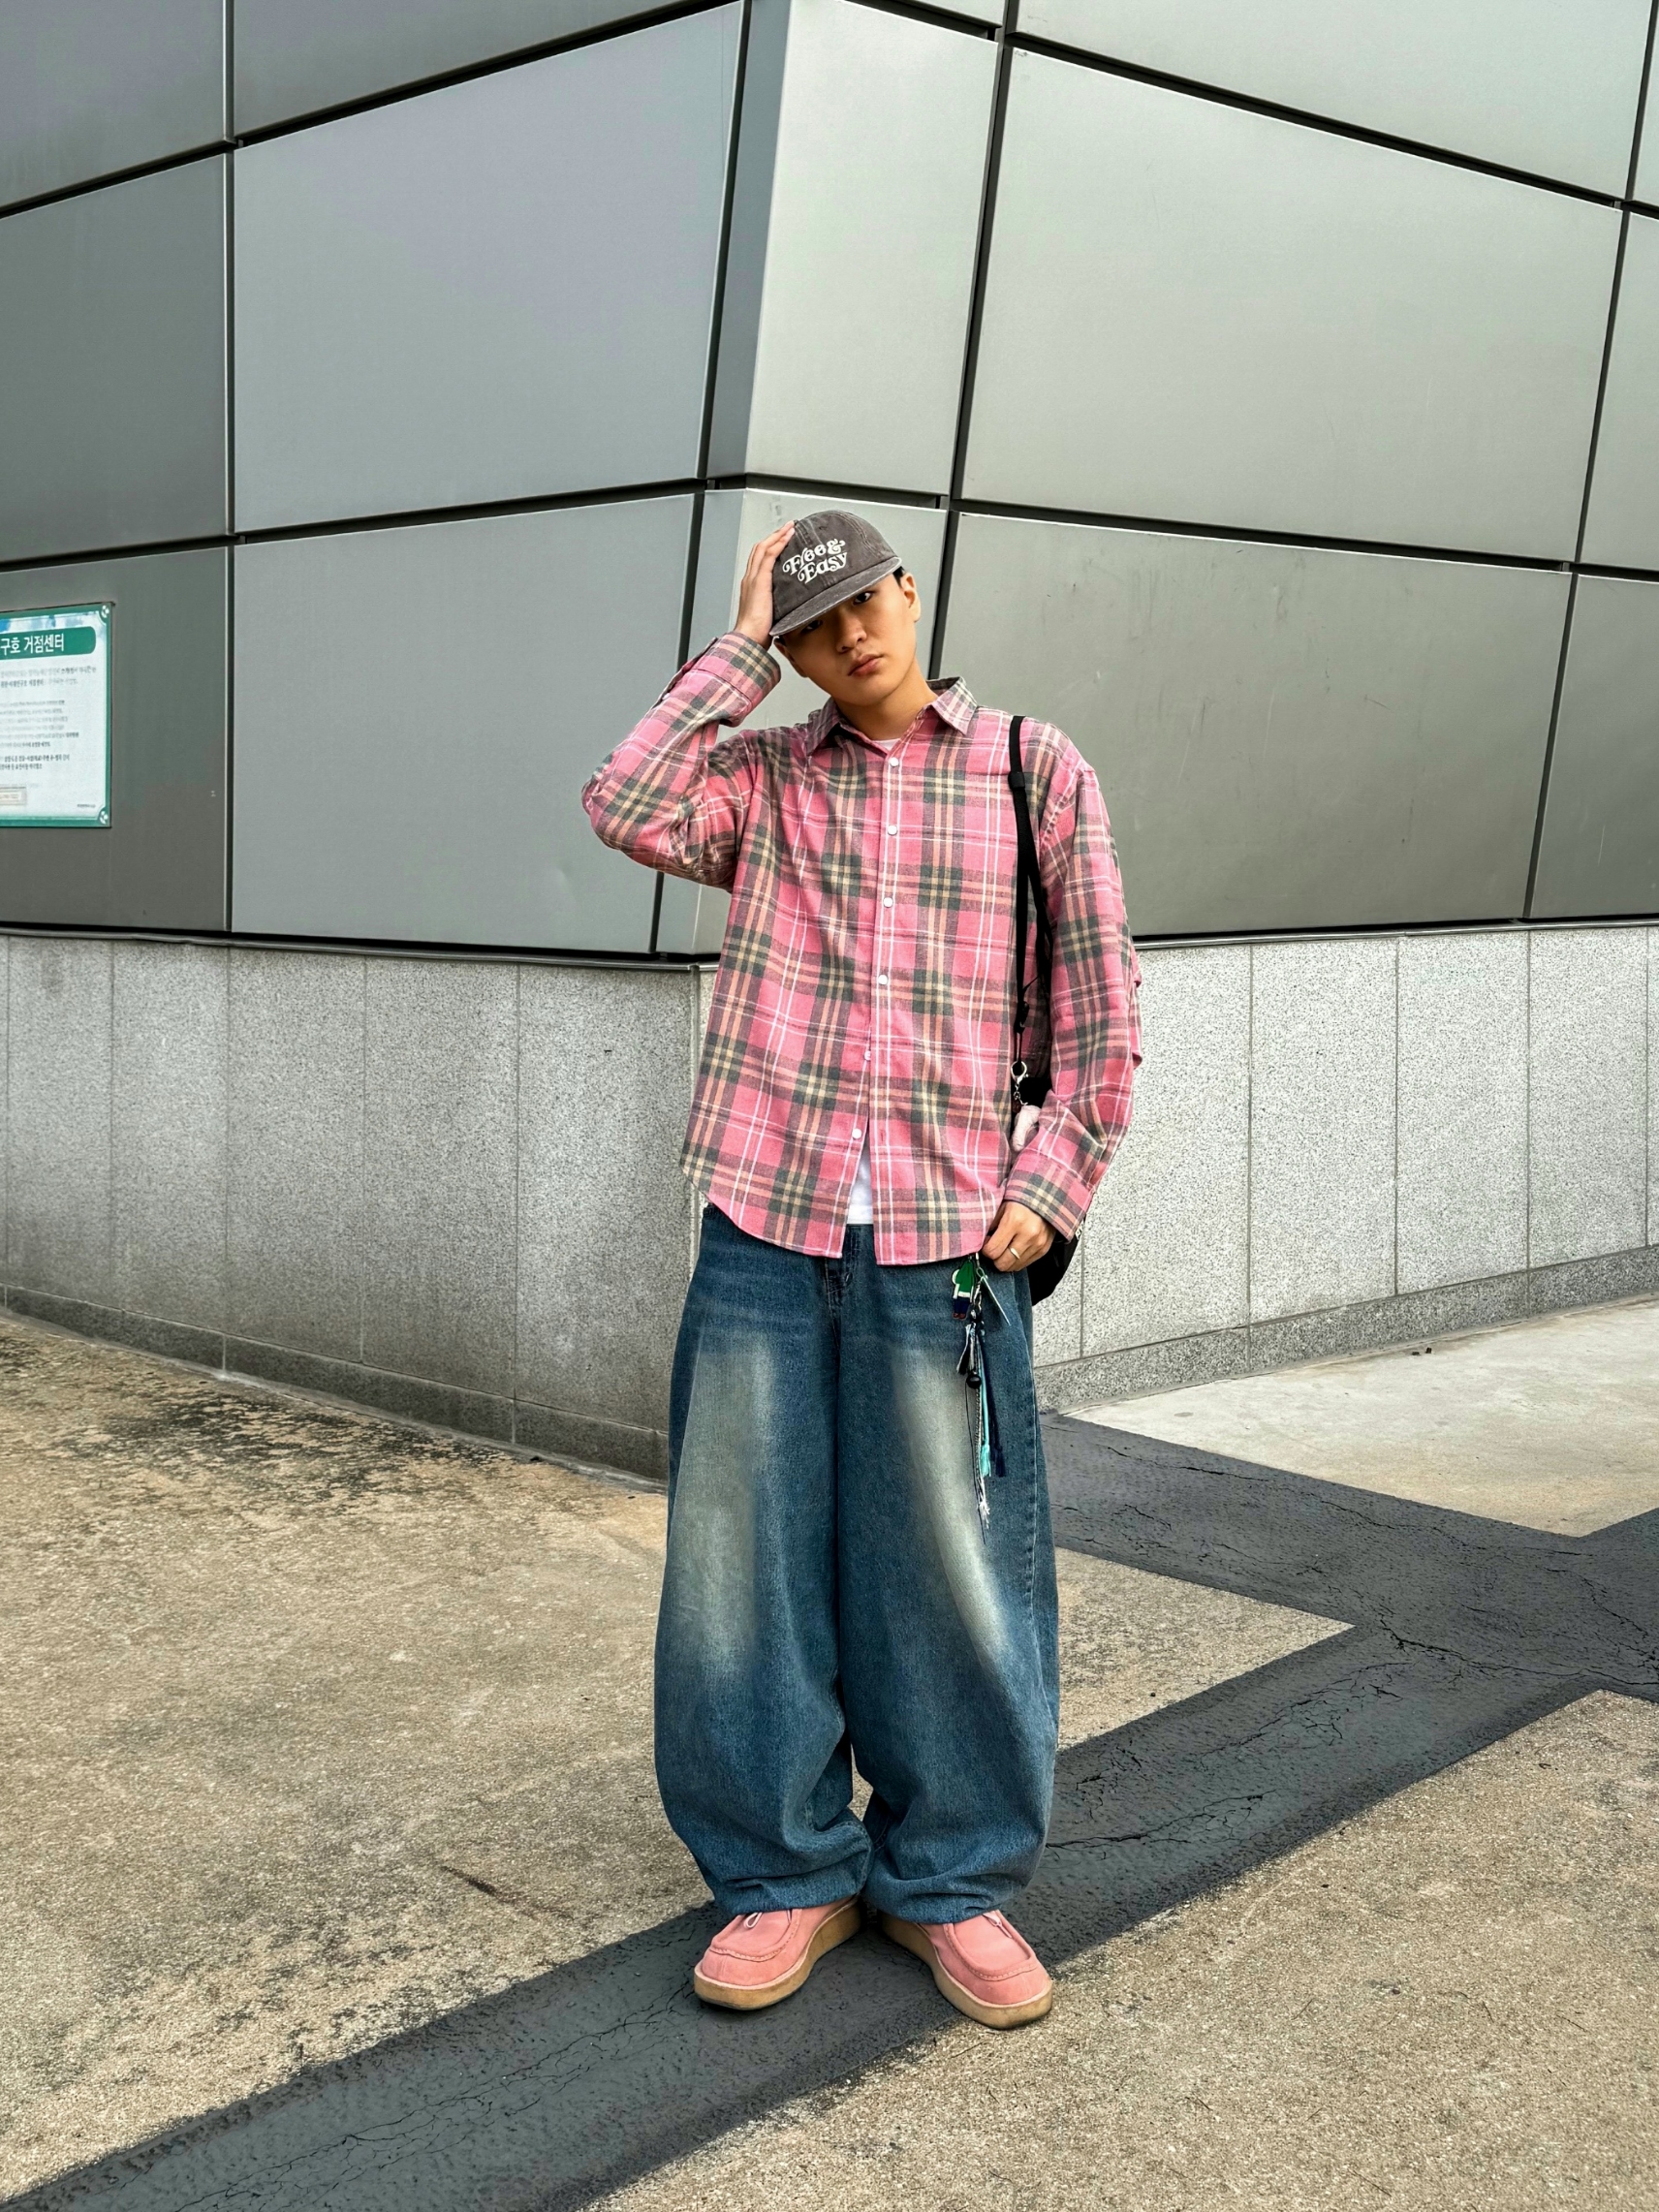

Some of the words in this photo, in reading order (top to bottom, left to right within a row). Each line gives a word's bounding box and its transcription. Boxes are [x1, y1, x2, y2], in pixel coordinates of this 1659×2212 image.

[797, 551, 848, 584] Easy
[0, 637, 21, 656] 구호
[23, 633, 65, 654] 거점센터
